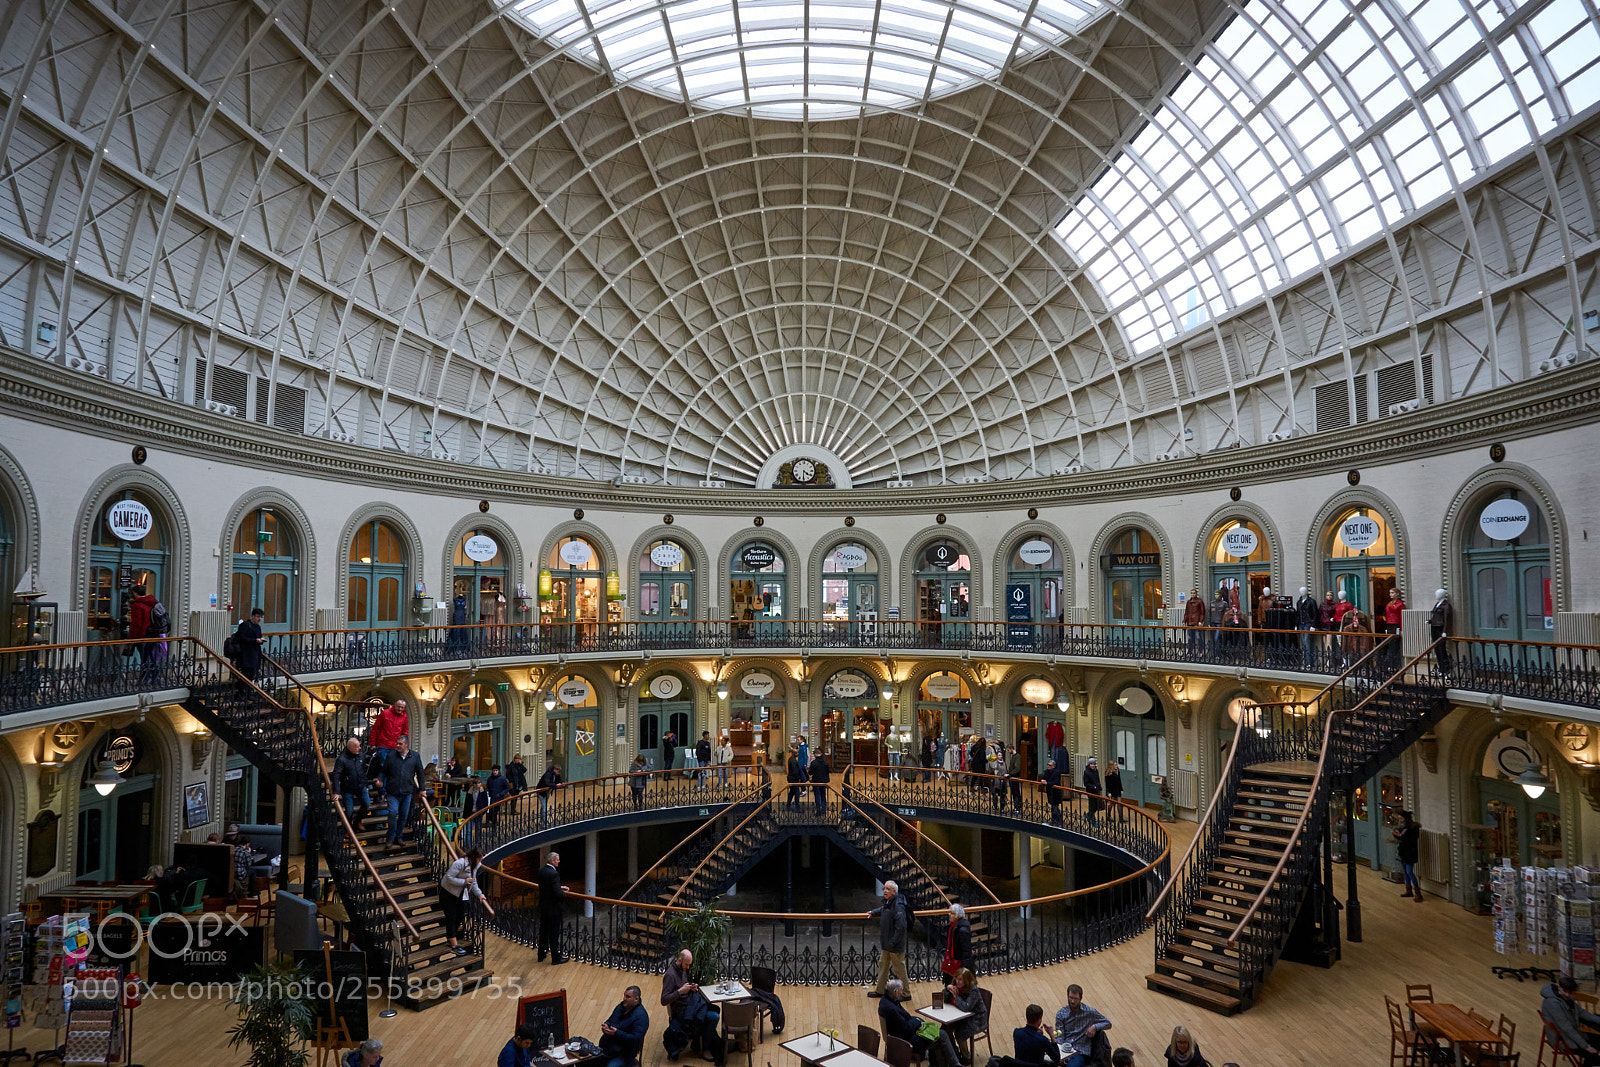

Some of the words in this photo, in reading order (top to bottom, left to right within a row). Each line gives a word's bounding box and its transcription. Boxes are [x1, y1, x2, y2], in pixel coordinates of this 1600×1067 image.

[138, 450, 143, 460] 2
[1491, 446, 1502, 458] 15
[1348, 473, 1356, 481] 16
[114, 510, 148, 530] CAMERAS
[1344, 524, 1359, 535] NEXT
[1360, 523, 1373, 534] ONE
[1226, 534, 1239, 544] NEXT
[1241, 534, 1252, 544] ONE
[1117, 556, 1136, 564] WAY
[1138, 556, 1155, 564] OUT
